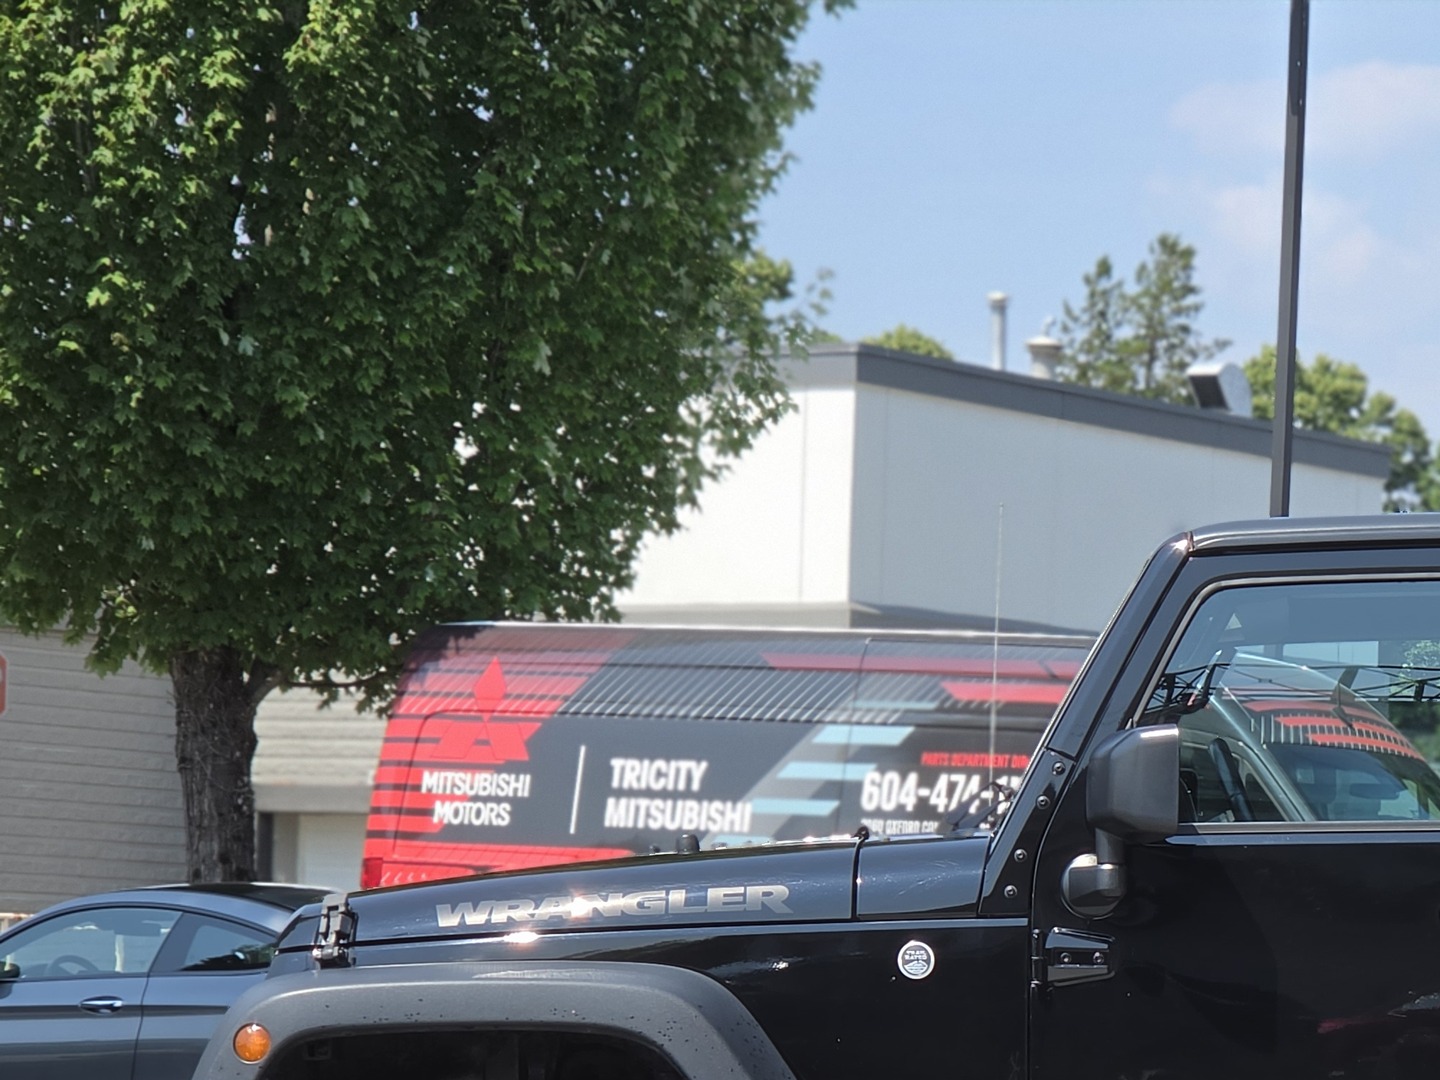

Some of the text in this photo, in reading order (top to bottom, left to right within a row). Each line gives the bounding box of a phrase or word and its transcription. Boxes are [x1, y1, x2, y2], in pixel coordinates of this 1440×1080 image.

[420, 770, 531, 798] MITSUBISHI
[610, 758, 708, 792] TRICITY
[432, 800, 511, 828] MOTORS
[604, 797, 752, 834] MITSUBISHI
[436, 884, 792, 928] WRANGLER
